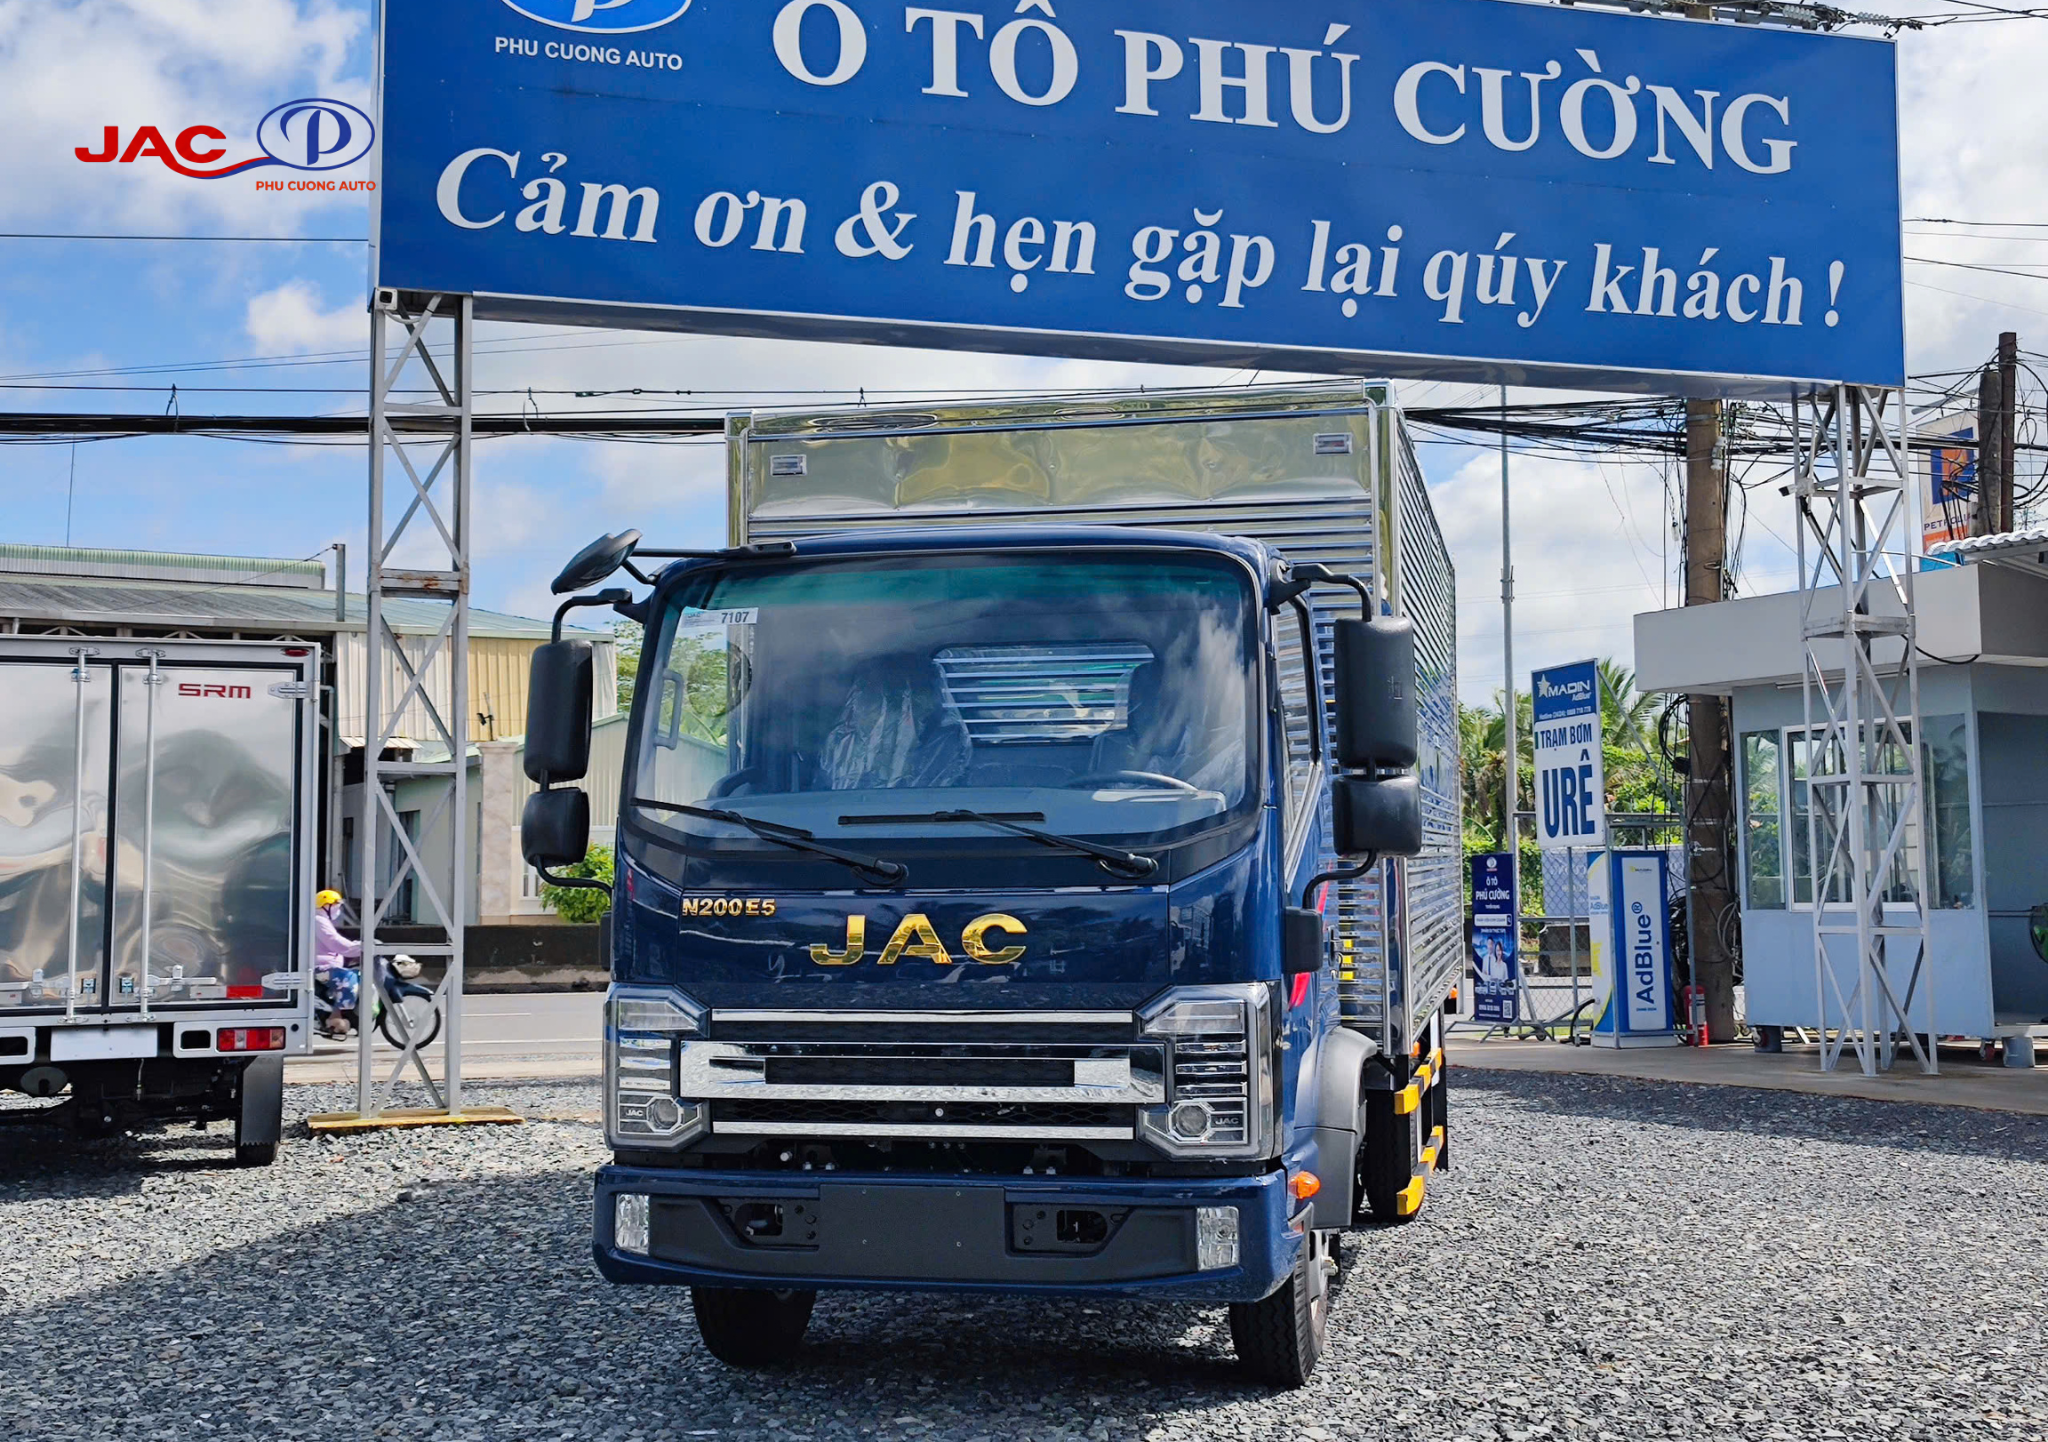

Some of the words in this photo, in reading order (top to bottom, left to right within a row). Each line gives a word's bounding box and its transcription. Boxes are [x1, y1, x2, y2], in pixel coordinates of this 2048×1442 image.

[495, 37, 538, 56] PHU
[545, 41, 621, 65] CUONG
[626, 51, 683, 71] AUTO
[905, 0, 1079, 106] TÔ
[1114, 23, 1361, 134] PHÚ
[1393, 48, 1798, 175] CƯỜNG
[436, 148, 660, 244] Cảm
[694, 190, 807, 255] ơn
[834, 180, 918, 260] &
[943, 190, 1096, 294] hẹn
[1124, 208, 1275, 308] gặp
[1301, 219, 1403, 318] lại
[1423, 232, 1568, 328] qúy
[1584, 243, 1804, 327] khách
[1824, 260, 1846, 328] !
[721, 611, 750, 624] 7107
[178, 683, 251, 699] SRM
[1548, 680, 1591, 697] MADIN
[1540, 727, 1568, 752] TRẠM
[1542, 748, 1596, 839] URÊ
[809, 912, 1029, 966] JAC
[626, 1109, 643, 1117] JAC
